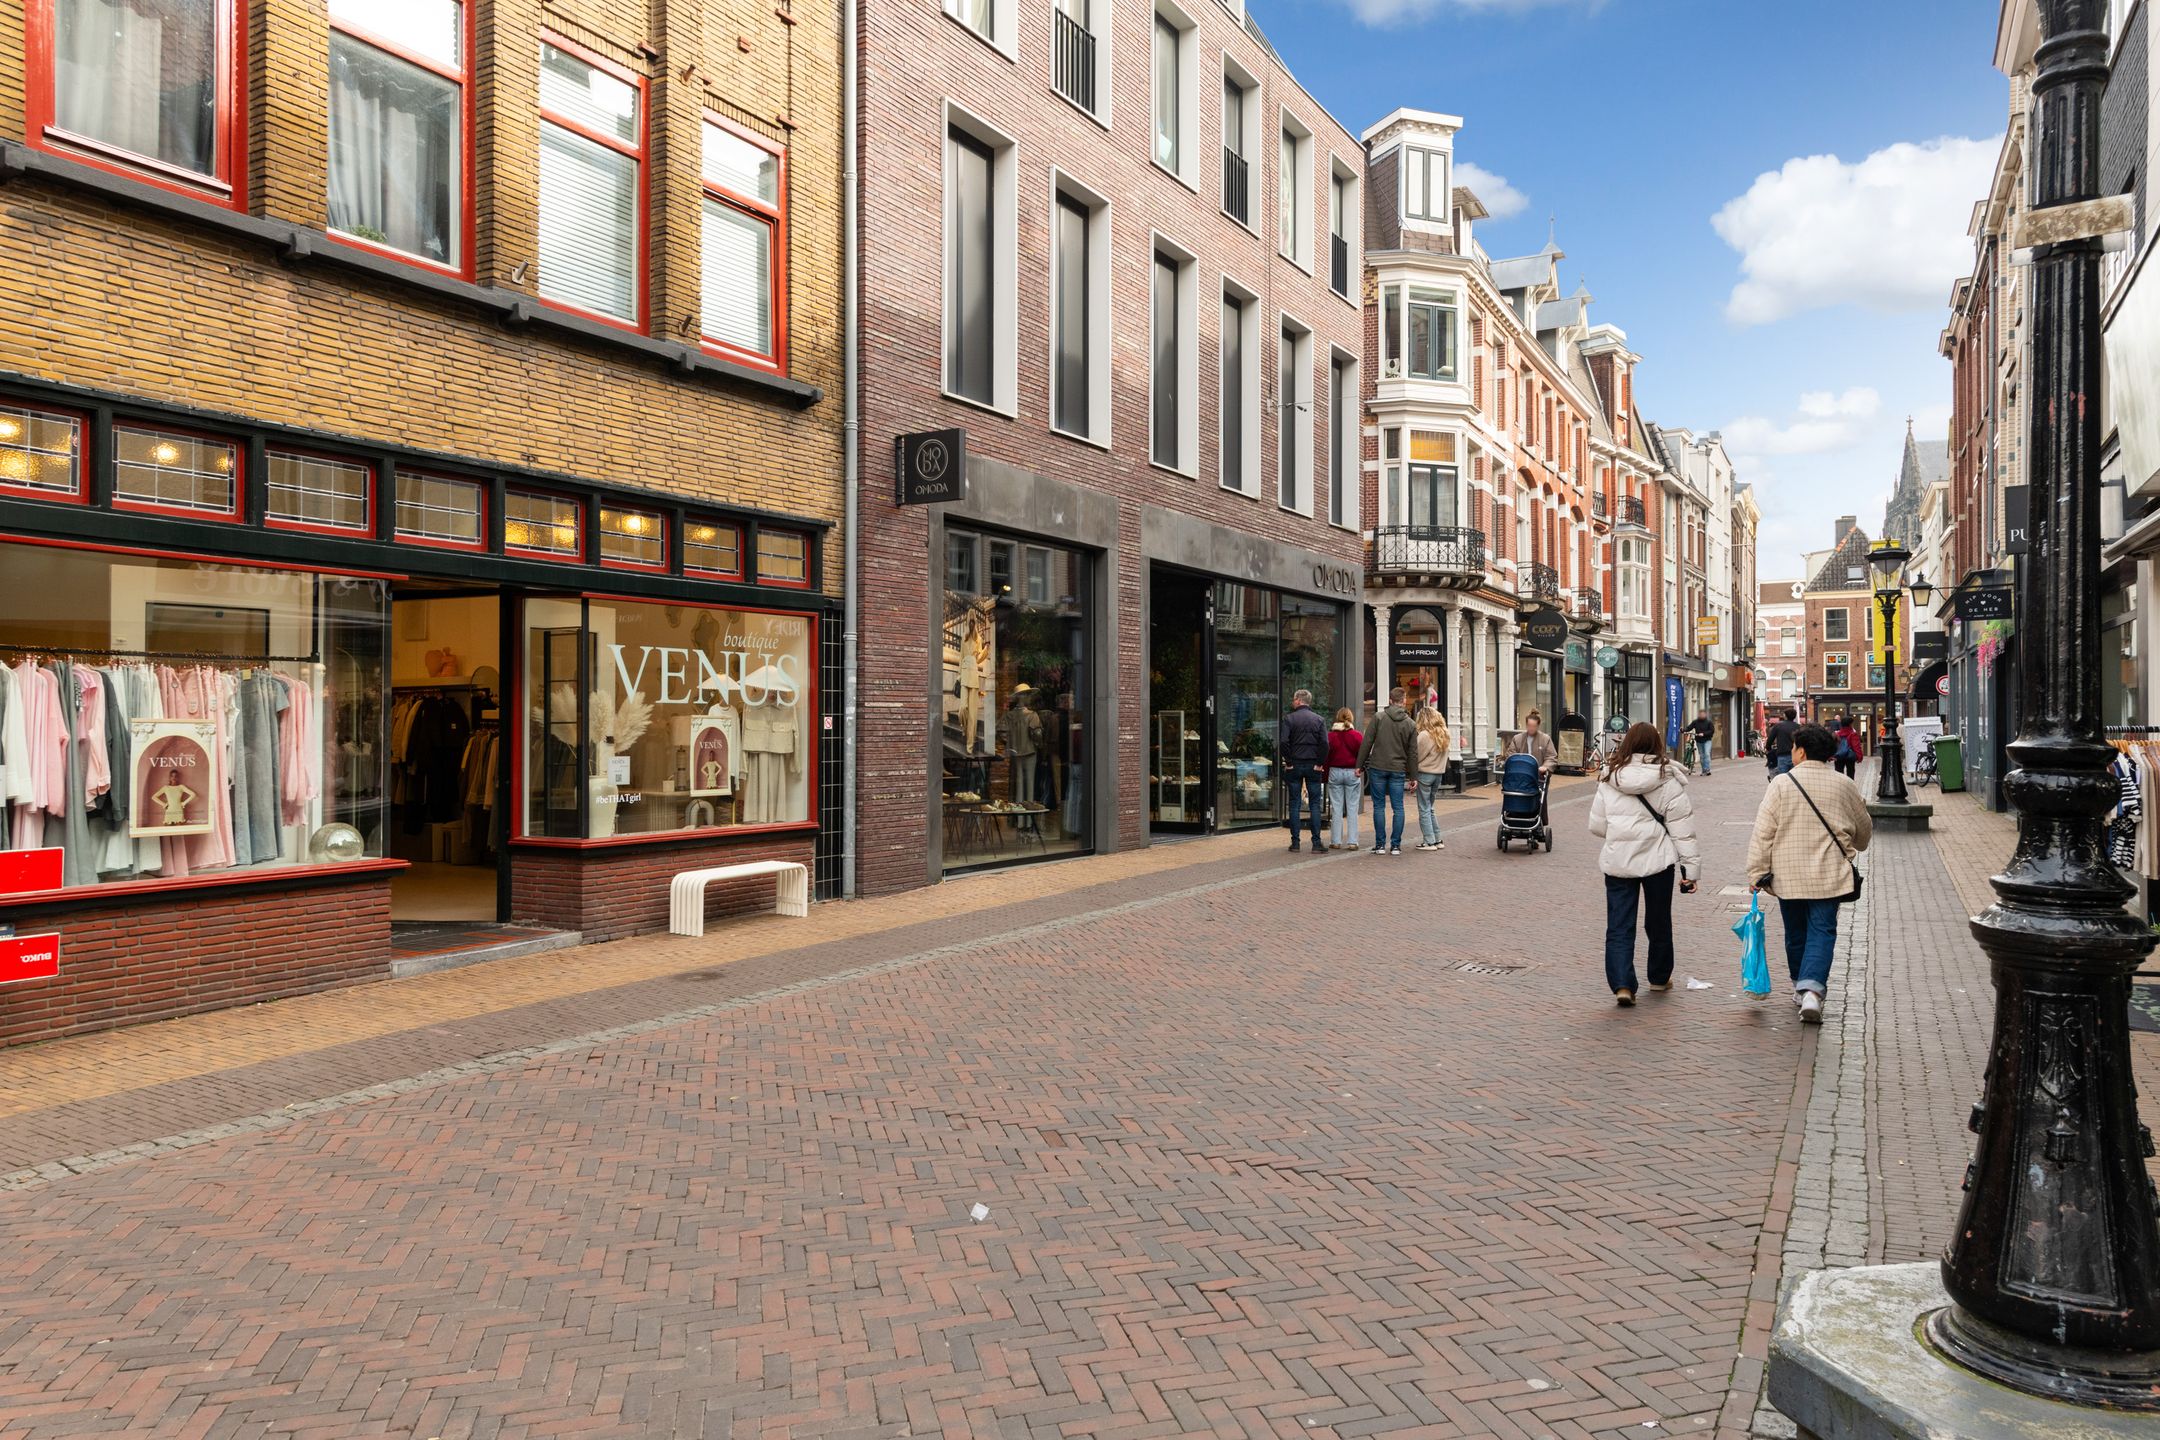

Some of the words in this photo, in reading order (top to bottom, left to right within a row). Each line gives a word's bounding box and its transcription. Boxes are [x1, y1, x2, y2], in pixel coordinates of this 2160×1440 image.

[914, 482, 949, 496] OMODA
[1313, 563, 1357, 597] OMODA
[1532, 624, 1562, 635] COZY
[723, 621, 780, 660] boutique
[606, 643, 801, 708] VENUS
[699, 740, 724, 750] VENUS
[149, 756, 197, 768] VENUS
[595, 791, 642, 804] #beTHATgirl
